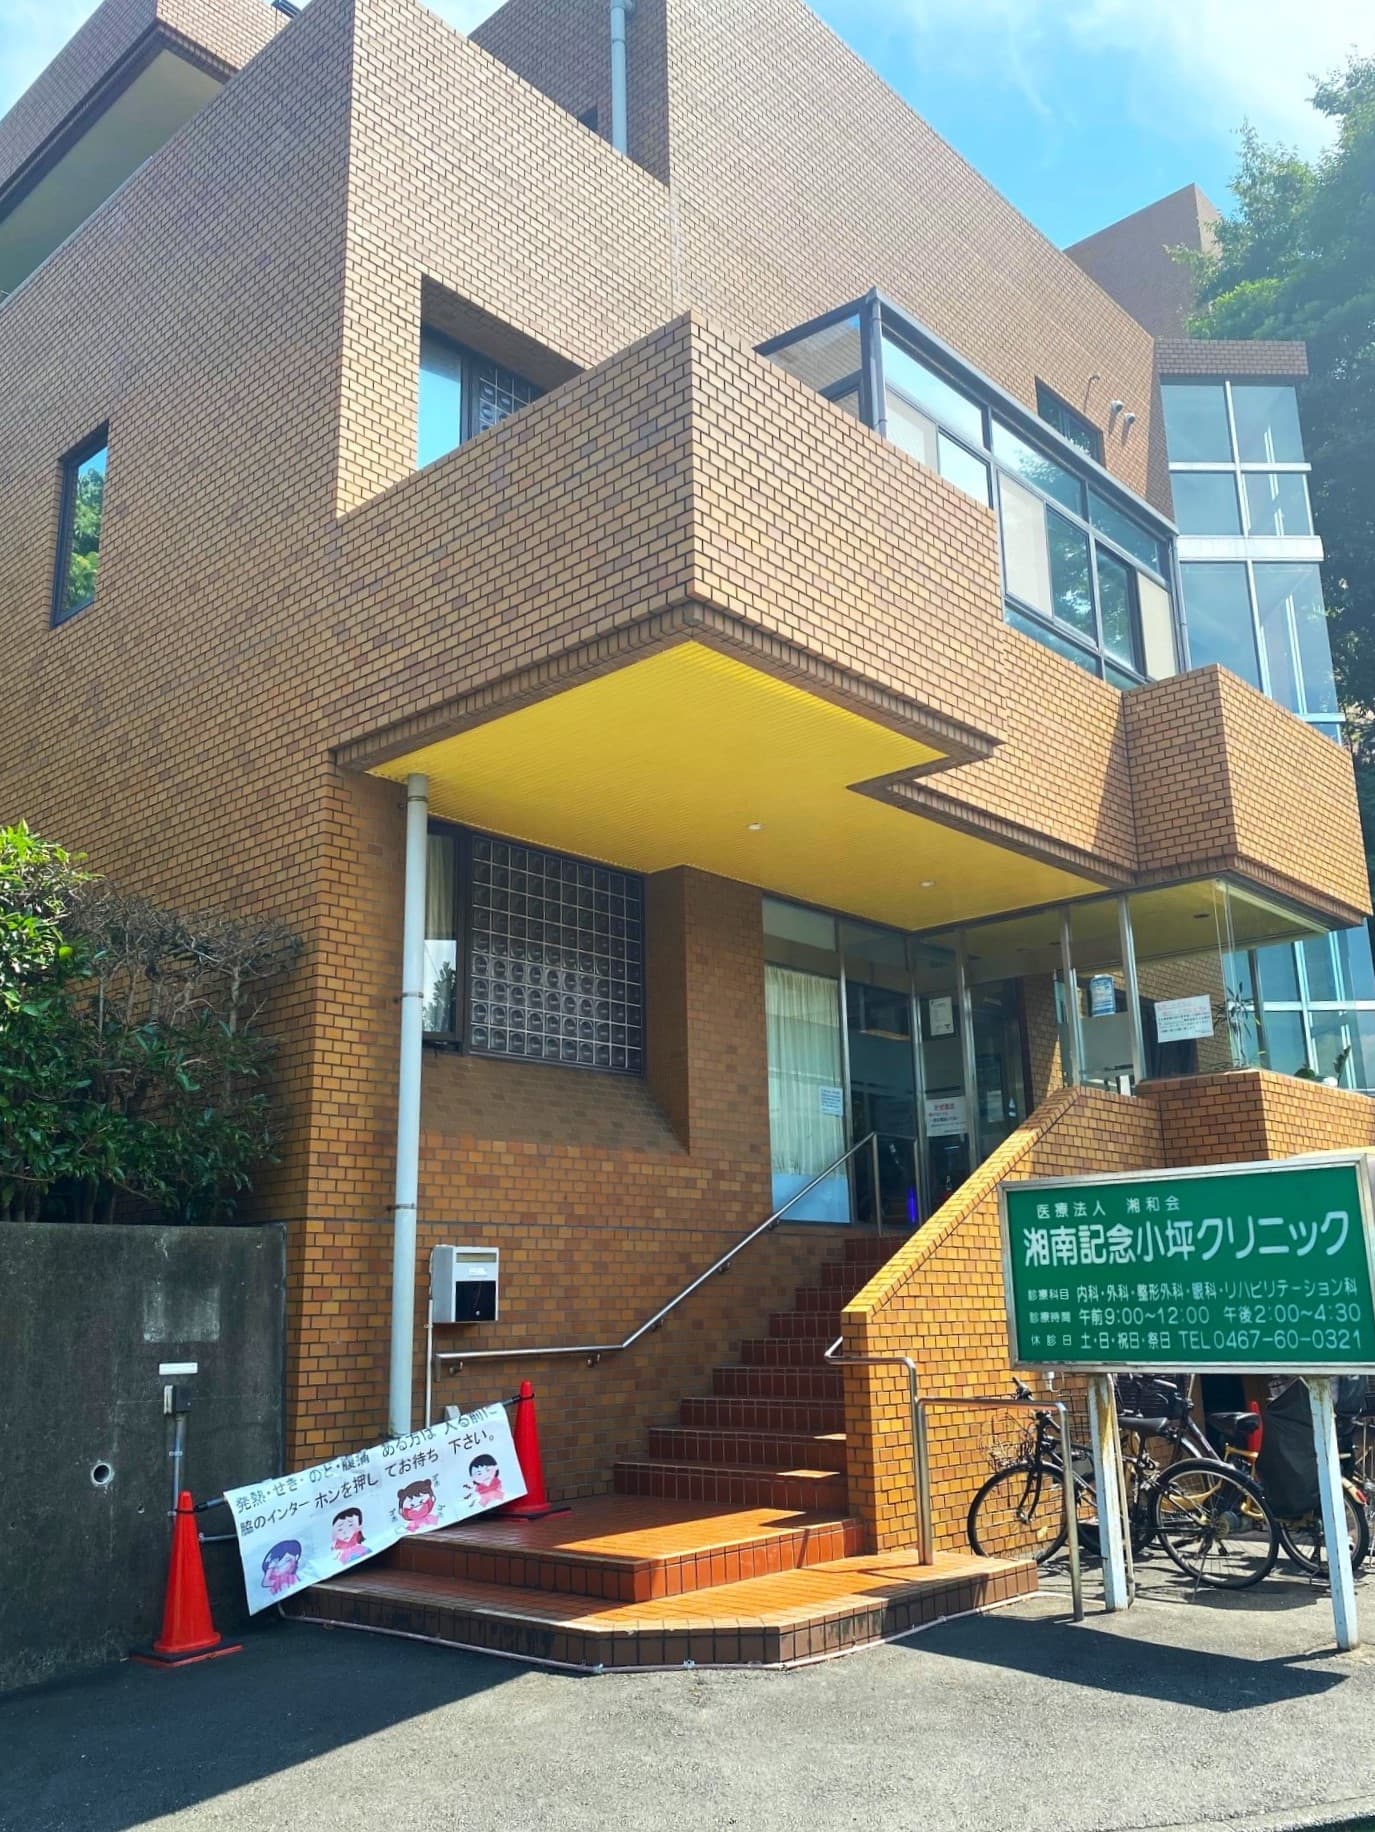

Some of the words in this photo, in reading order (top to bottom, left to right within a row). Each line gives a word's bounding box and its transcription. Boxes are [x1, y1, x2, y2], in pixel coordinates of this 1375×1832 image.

[1036, 1200, 1106, 1219] 医療法人
[1126, 1195, 1180, 1214] 湘和会
[1023, 1210, 1349, 1267] 湘南記念小坪クリニック
[1028, 1288, 1070, 1301] 診療科目
[1029, 1311, 1072, 1324] 診療時間
[1178, 1331, 1211, 1350] TEL
[1213, 1329, 1361, 1349] 0467-60-0321
